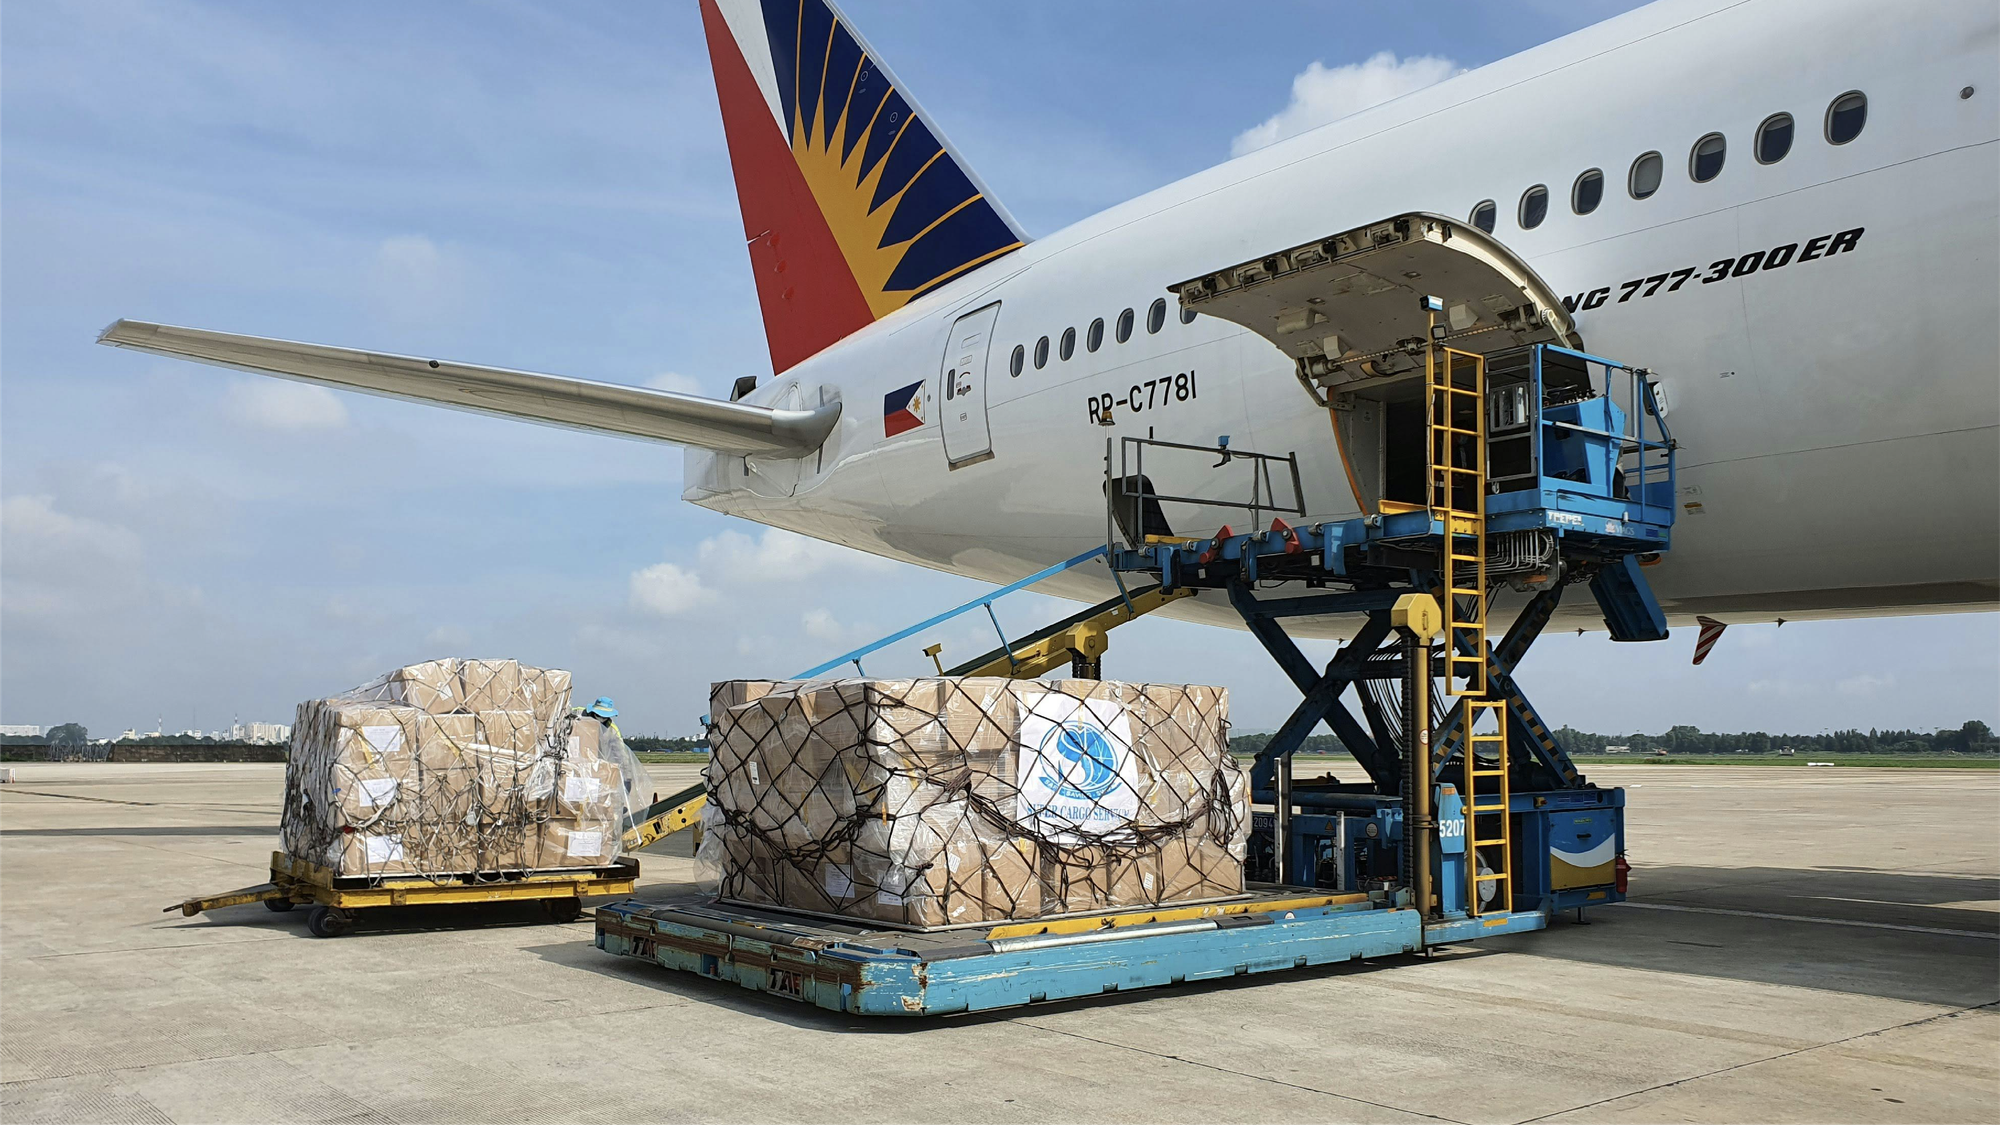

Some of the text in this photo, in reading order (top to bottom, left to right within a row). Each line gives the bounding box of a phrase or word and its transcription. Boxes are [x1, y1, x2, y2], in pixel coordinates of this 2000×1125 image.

[1617, 227, 1865, 303] 777-300ER
[1088, 370, 1196, 424] RP-C7781
[1060, 805, 1091, 821] CARGO
[1439, 819, 1466, 838] 5207
